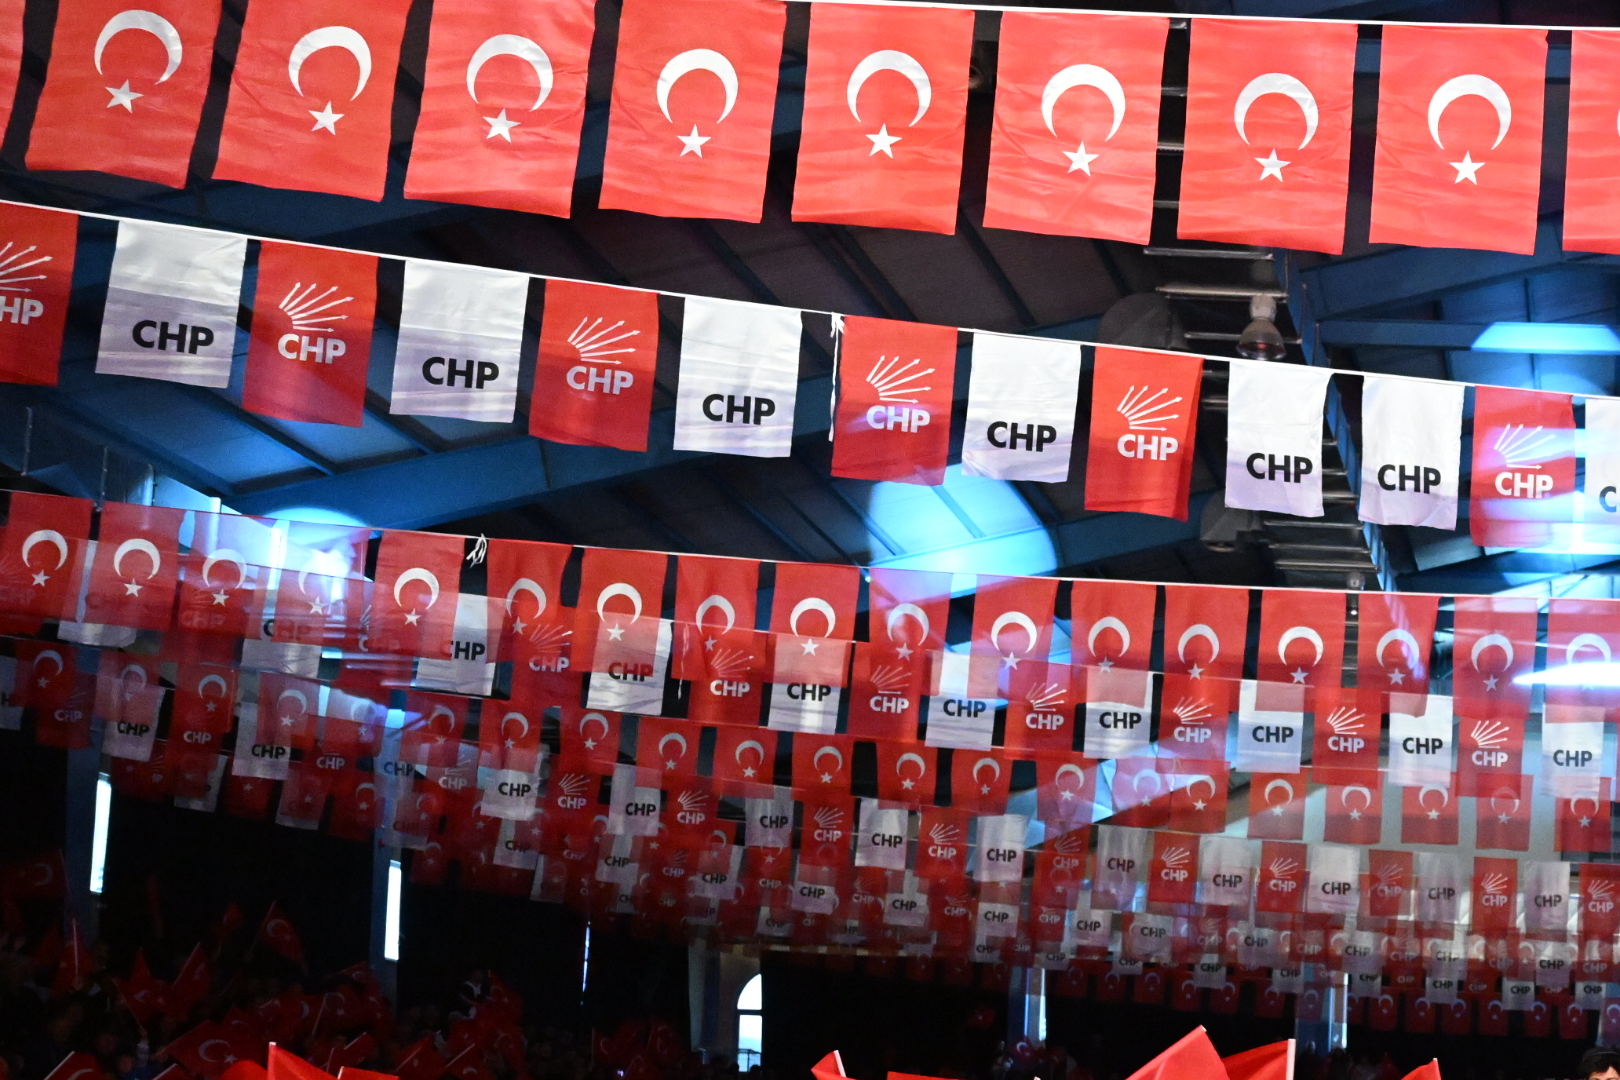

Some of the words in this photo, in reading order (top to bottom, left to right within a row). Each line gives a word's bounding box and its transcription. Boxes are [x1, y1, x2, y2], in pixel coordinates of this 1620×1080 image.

[0, 296, 44, 325] HP
[132, 320, 214, 354] CHP
[277, 333, 346, 364] CHP
[422, 357, 499, 389] CHP
[566, 366, 634, 397] CHP
[702, 394, 776, 425] CHP
[866, 405, 930, 433] CHP
[987, 421, 1057, 453] CHP
[1117, 434, 1178, 461] CHP
[1246, 452, 1313, 483] CHP
[1377, 464, 1441, 495] CHP
[1495, 472, 1553, 500] CHP
[446, 640, 485, 661] CHP
[529, 657, 569, 672] CHP
[608, 662, 653, 682] CHP
[710, 680, 750, 697] CHP
[787, 684, 831, 701] CHP
[870, 696, 909, 713] CHP
[943, 700, 986, 718] CHP
[1026, 714, 1064, 730] CHP
[1099, 712, 1141, 729] CHP
[117, 721, 150, 736] CHP
[1174, 728, 1211, 743] CHP
[1252, 726, 1294, 743] CHP
[183, 730, 212, 744] CHP
[1328, 737, 1365, 752] CHP
[1403, 737, 1443, 754] CHP
[251, 745, 286, 759] CHP
[1471, 751, 1508, 767] CHP
[1553, 750, 1592, 767] CHP
[316, 756, 345, 769] CHP
[384, 762, 414, 776] CHP
[439, 777, 467, 790] CHP
[498, 783, 531, 797] CHP
[558, 796, 586, 809] CHP
[625, 803, 656, 816] CHP
[677, 812, 705, 824] CHP
[759, 815, 789, 829] CHP
[814, 829, 842, 842] CHP
[871, 833, 902, 847] CHP
[928, 846, 956, 858] CHP
[986, 849, 1017, 862] CHP
[604, 856, 630, 868] CHP
[1052, 857, 1079, 869] CHP
[1107, 858, 1134, 871] CHP
[702, 873, 727, 885] CHP
[1161, 869, 1188, 881] CHP
[1213, 873, 1242, 888] CHP
[800, 886, 825, 898] CHP
[1269, 880, 1296, 891] CHP
[1321, 882, 1351, 895] CHP
[1428, 887, 1455, 900] CHP
[1482, 895, 1507, 906] CHP
[892, 899, 917, 911] CHP
[1534, 895, 1562, 908] CHP
[1588, 901, 1614, 912] CHP
[984, 911, 1009, 923] CHP
[1076, 920, 1101, 932] CHP
[1140, 927, 1166, 939] CHP
[1539, 959, 1564, 970] CHP
